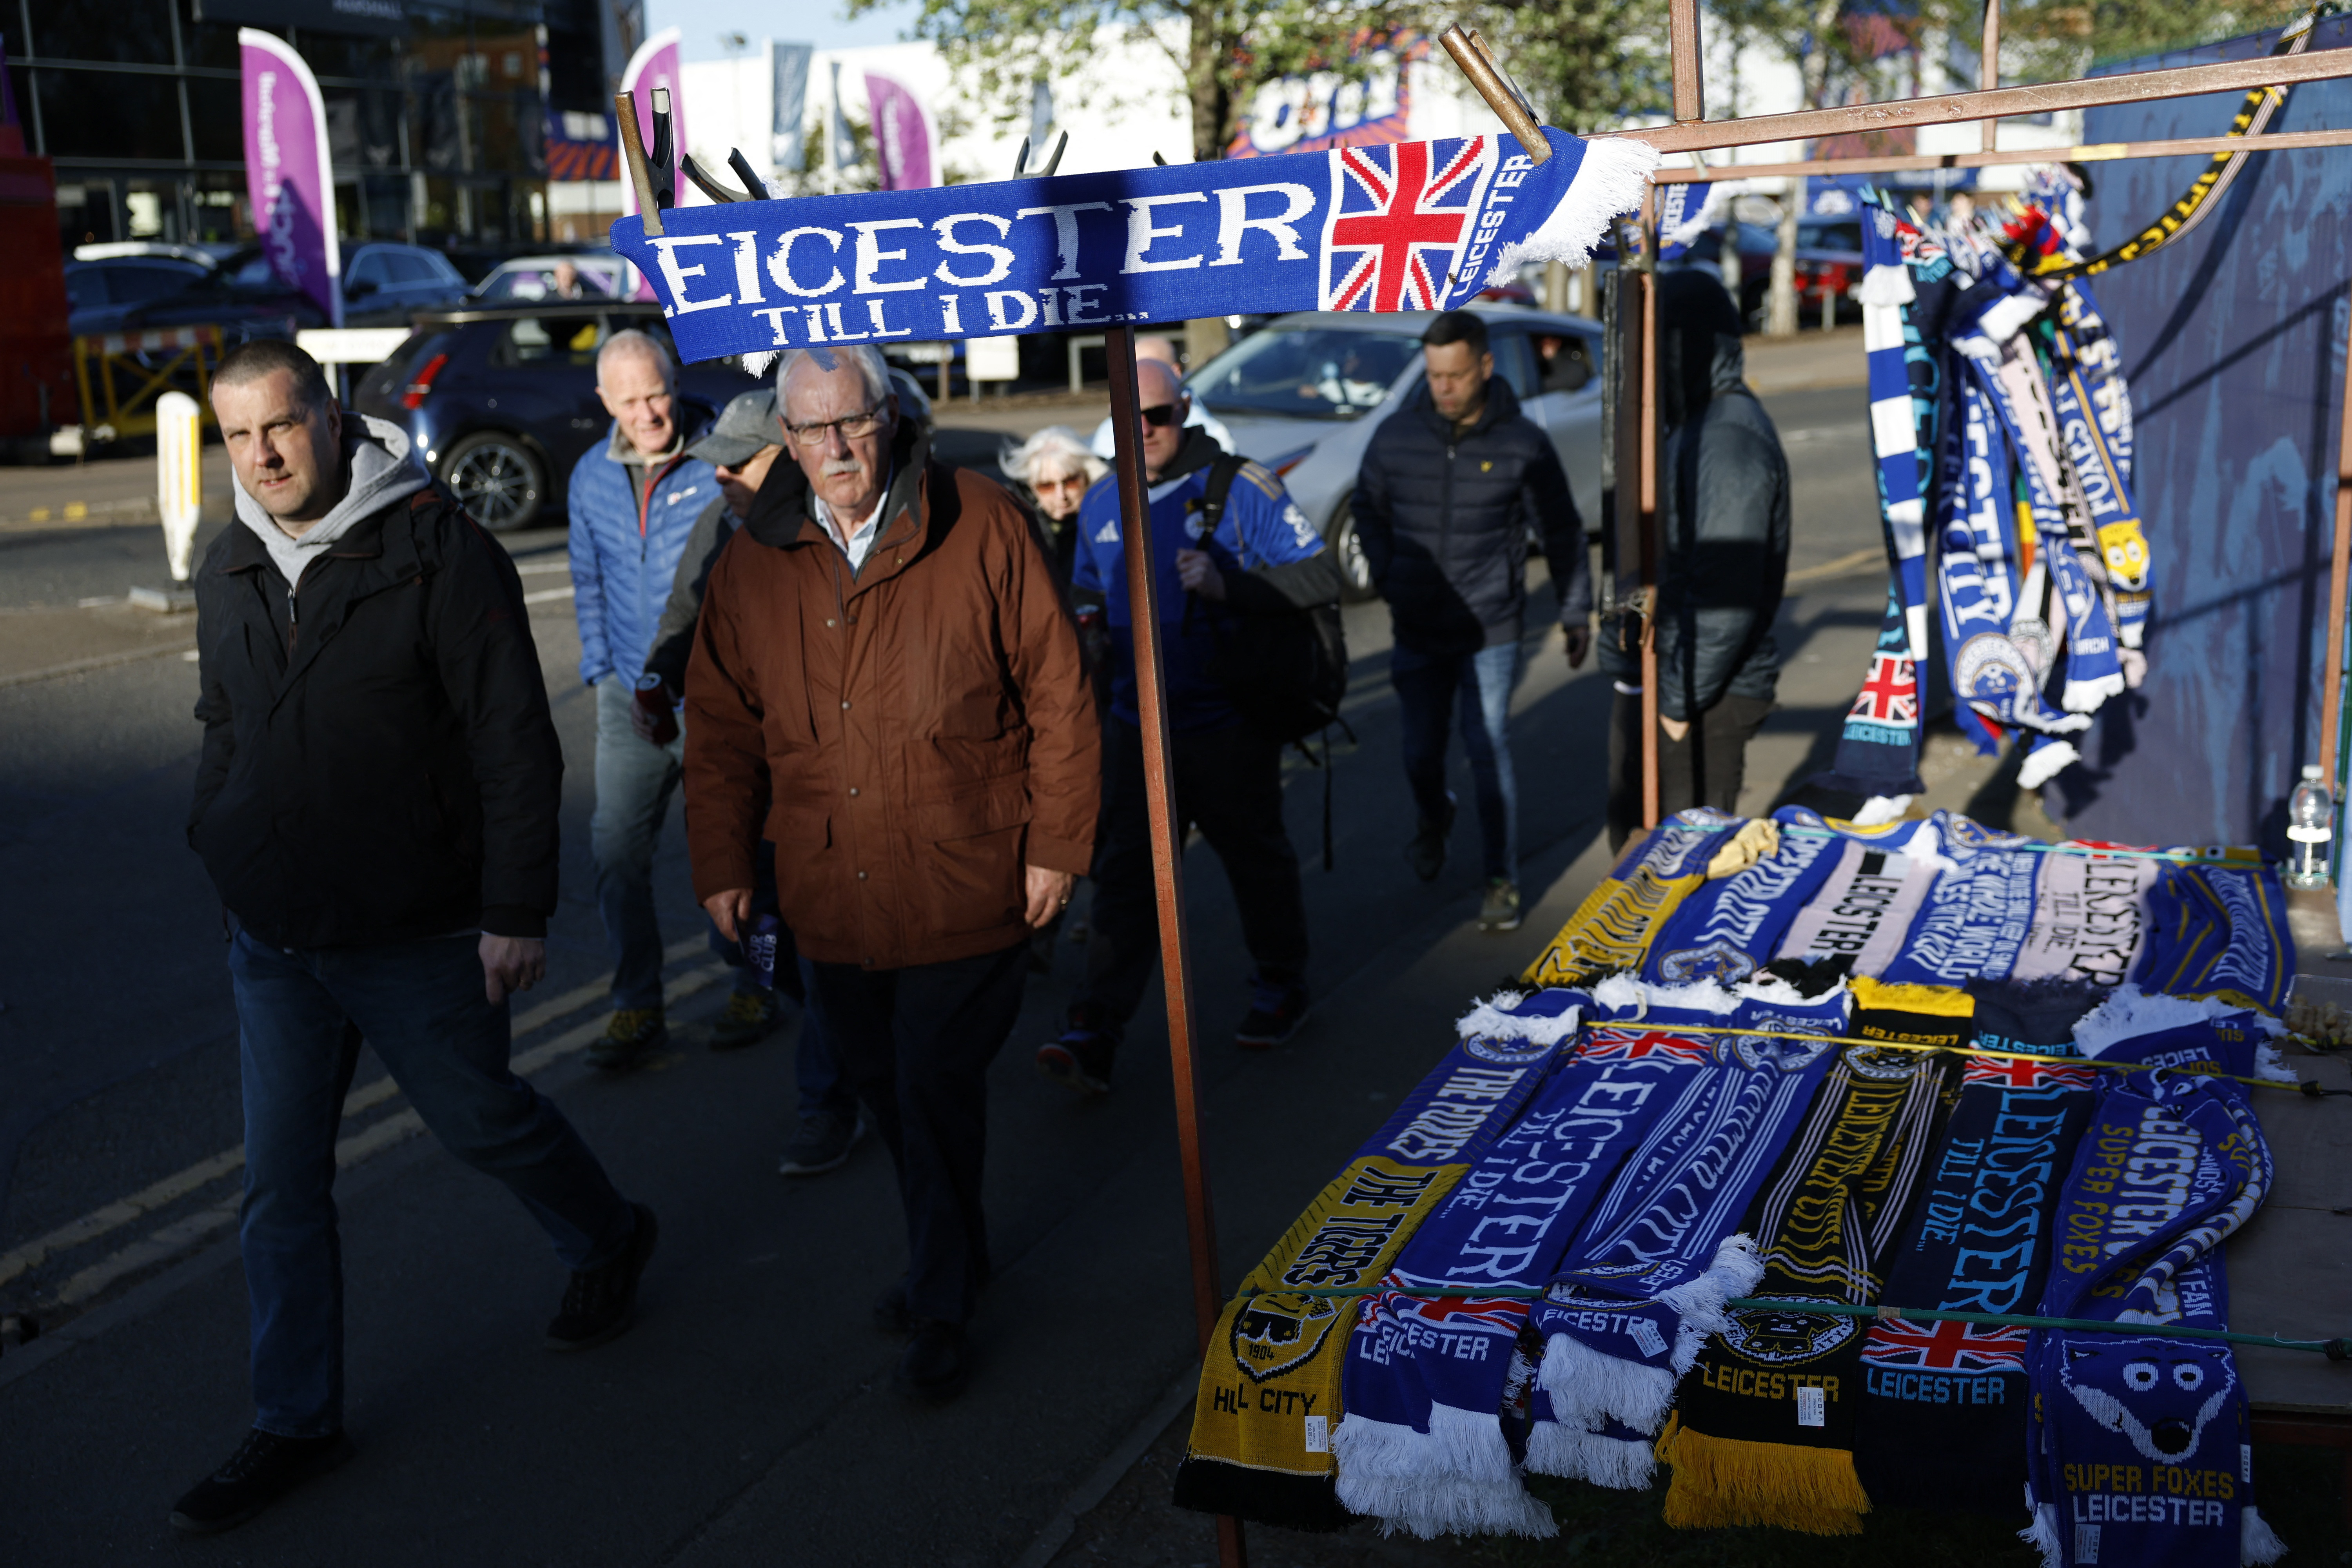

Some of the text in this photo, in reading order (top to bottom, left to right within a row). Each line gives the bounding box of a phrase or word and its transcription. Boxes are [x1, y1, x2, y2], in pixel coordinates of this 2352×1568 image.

[1453, 154, 1535, 297] LEICESTER
[645, 182, 1316, 318] EICESTER
[752, 283, 1149, 345] TILL I DIE...
[2063, 418, 2120, 517] FOXES
[749, 934, 764, 965] OUR
[760, 933, 777, 972] CLUB
[1861, 1024, 1960, 1046] LEICESTER
[1385, 1067, 1528, 1161] THE FOXES
[1484, 1156, 1518, 1165] I
[1936, 1136, 1985, 1182] TILL
[2080, 1123, 2134, 1194] SUPER
[1932, 1189, 1967, 1200] I
[1936, 1087, 2069, 1315] LEICESTER
[1283, 1165, 1441, 1287] THE TIGERS
[2062, 1199, 2110, 1274] FOXES
[2179, 1280, 2213, 1316] FAN
[1249, 1343, 1275, 1361] 1904
[1260, 1388, 1316, 1416] CITY
[1702, 1361, 1840, 1403] LEICESTER
[1866, 1368, 2005, 1405] LEICESTER
[2064, 1463, 2234, 1500] SUPER FOXES
[2073, 1494, 2224, 1527] LEICESTER
